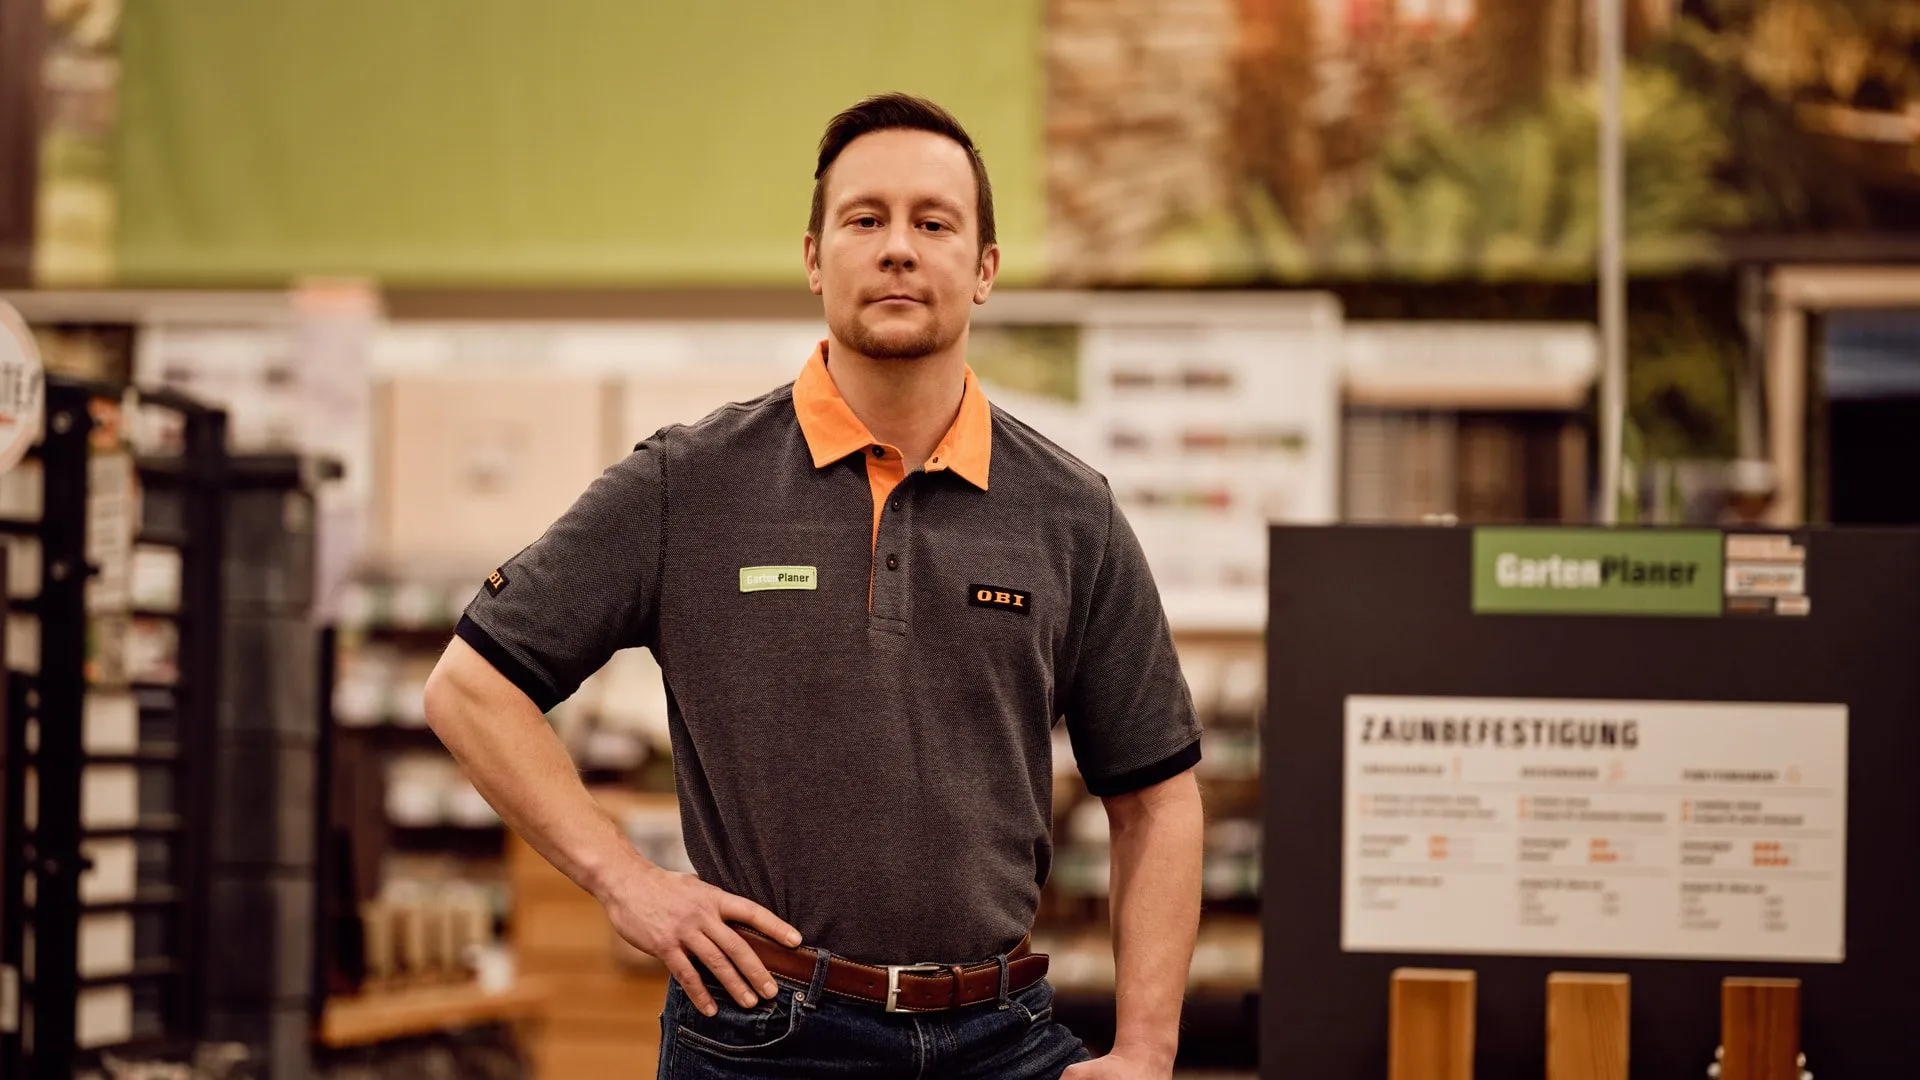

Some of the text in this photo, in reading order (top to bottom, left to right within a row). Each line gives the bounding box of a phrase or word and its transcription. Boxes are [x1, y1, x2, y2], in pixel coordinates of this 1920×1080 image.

[488, 570, 504, 589] BI
[1495, 552, 1698, 588] GartenPlaner
[977, 589, 1024, 607] OBI
[1361, 715, 1639, 748] ZAUNBEFESTIGUNG
